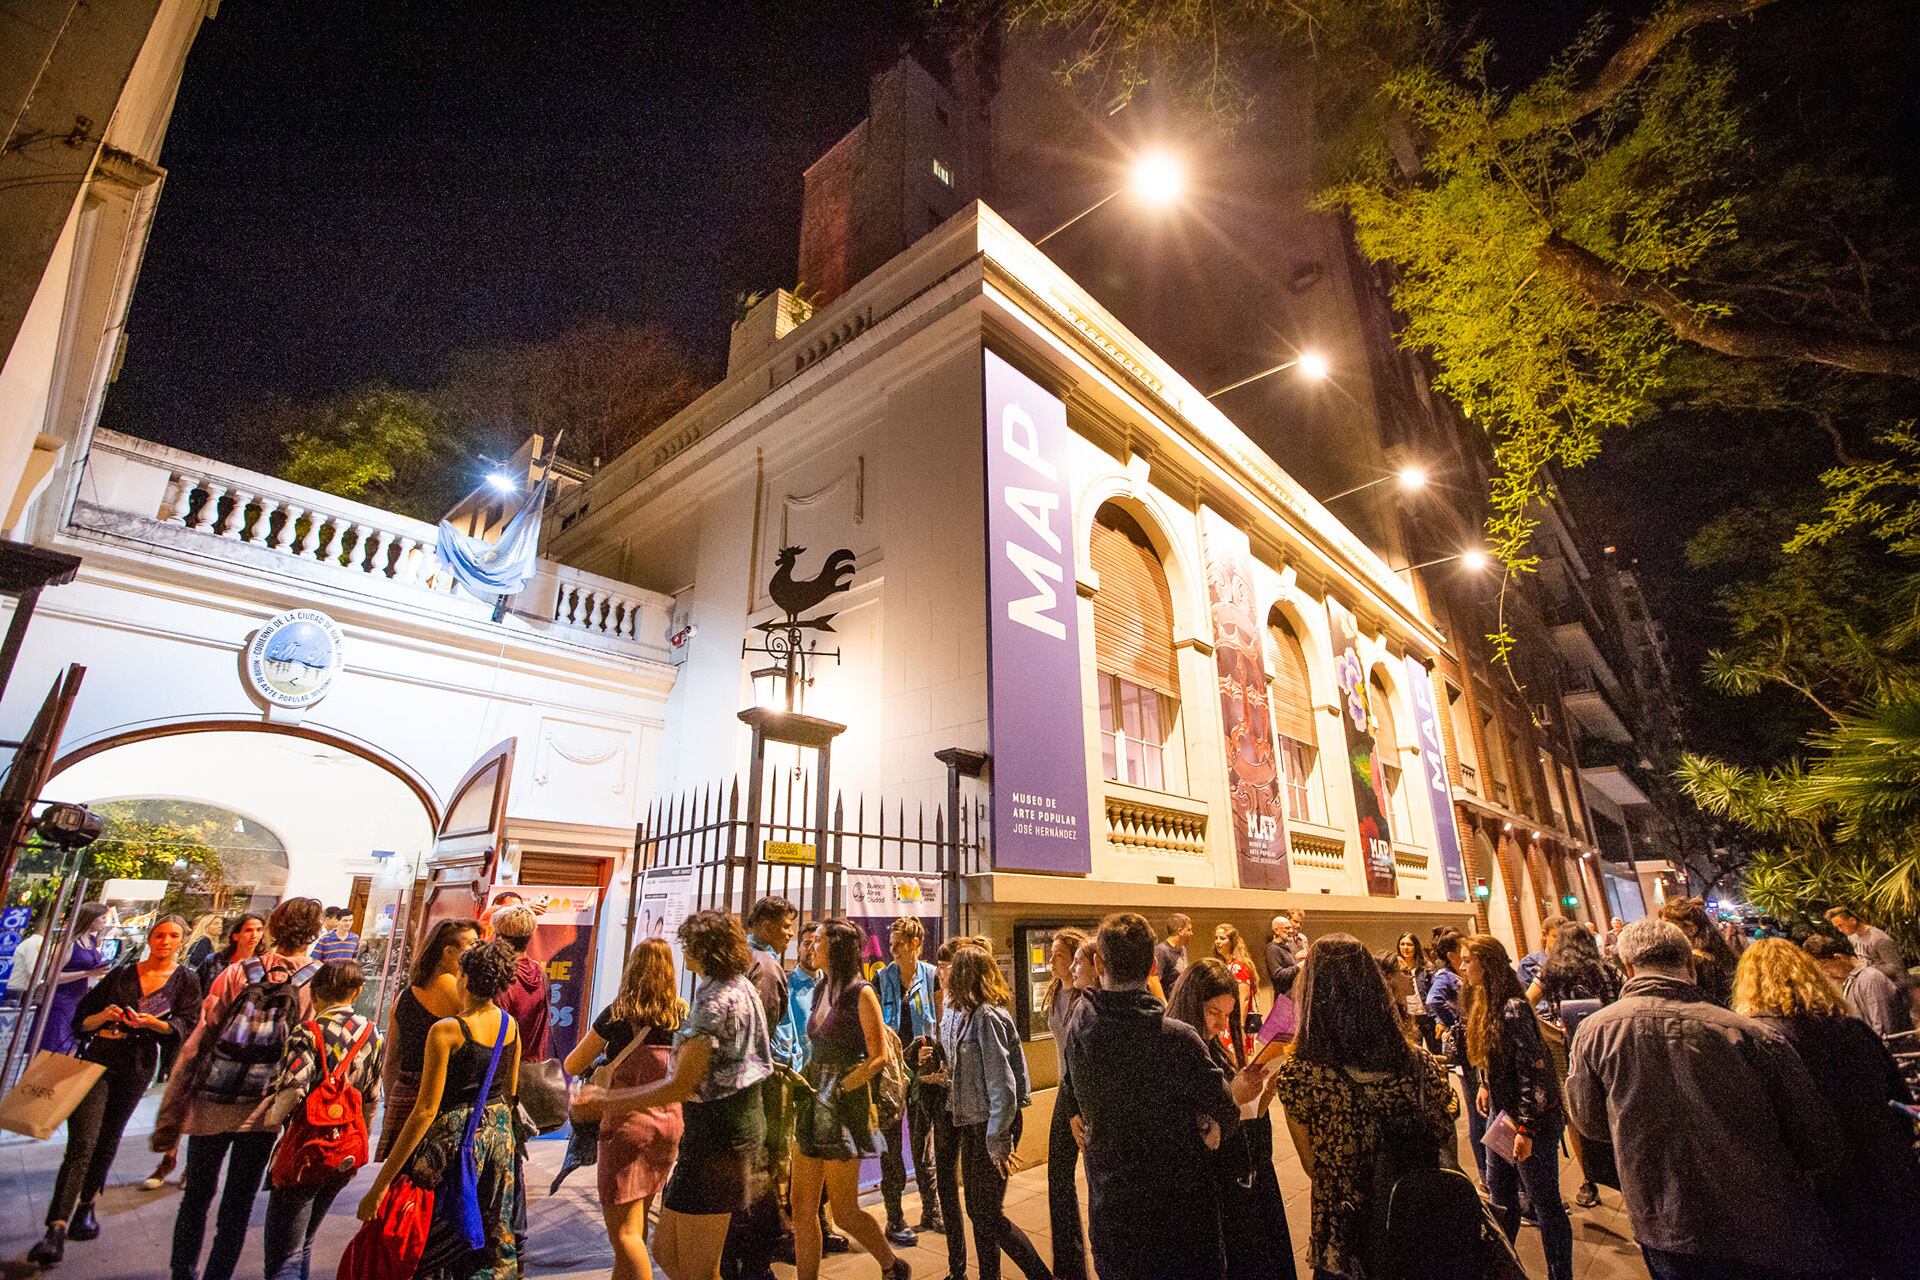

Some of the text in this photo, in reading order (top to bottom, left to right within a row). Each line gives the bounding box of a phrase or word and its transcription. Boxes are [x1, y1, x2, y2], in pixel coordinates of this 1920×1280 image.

[1002, 401, 1067, 641] MAP
[273, 618, 284, 628] DE
[284, 613, 295, 622] LA
[297, 612, 324, 624] CIUDAD
[260, 683, 277, 698] ARTE
[278, 694, 309, 703] POPULAR
[1415, 678, 1446, 793] MAP
[1012, 792, 1057, 809] MUSEO DE
[1012, 807, 1076, 826] ARTE POPULAR
[1246, 811, 1277, 841] MAP
[1013, 822, 1077, 840] JOSÉ HERNÁNDEZ
[866, 882, 886, 890] Buenos
